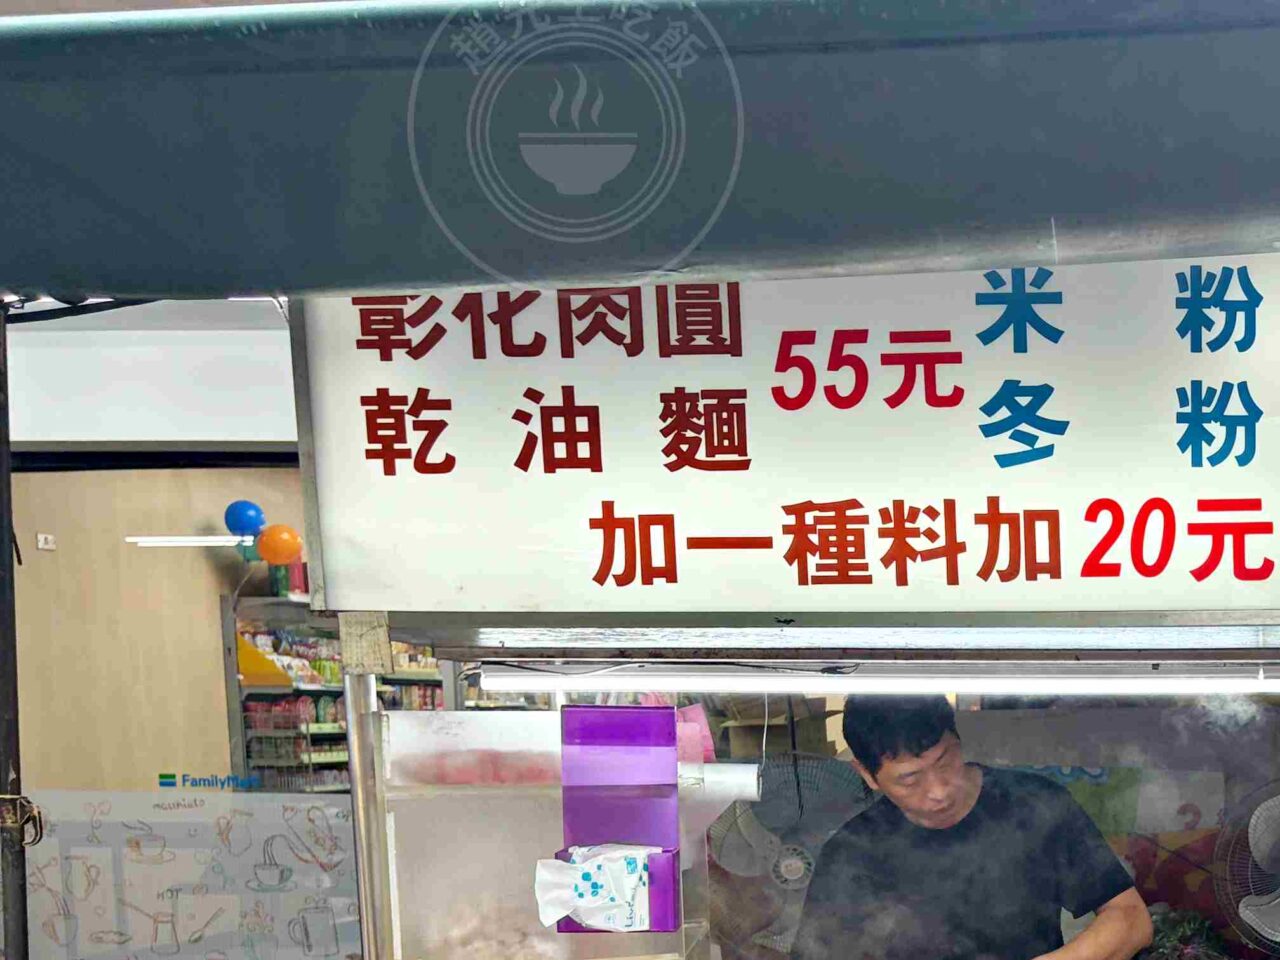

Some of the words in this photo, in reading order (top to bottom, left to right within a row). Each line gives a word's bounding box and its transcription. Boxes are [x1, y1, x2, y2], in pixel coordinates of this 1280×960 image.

[351, 281, 743, 361] 彰化肉圓
[975, 265, 1263, 354] 米粉
[771, 328, 965, 411] 55元
[360, 386, 752, 476] 乾油麵
[979, 379, 1263, 469] 冬粉
